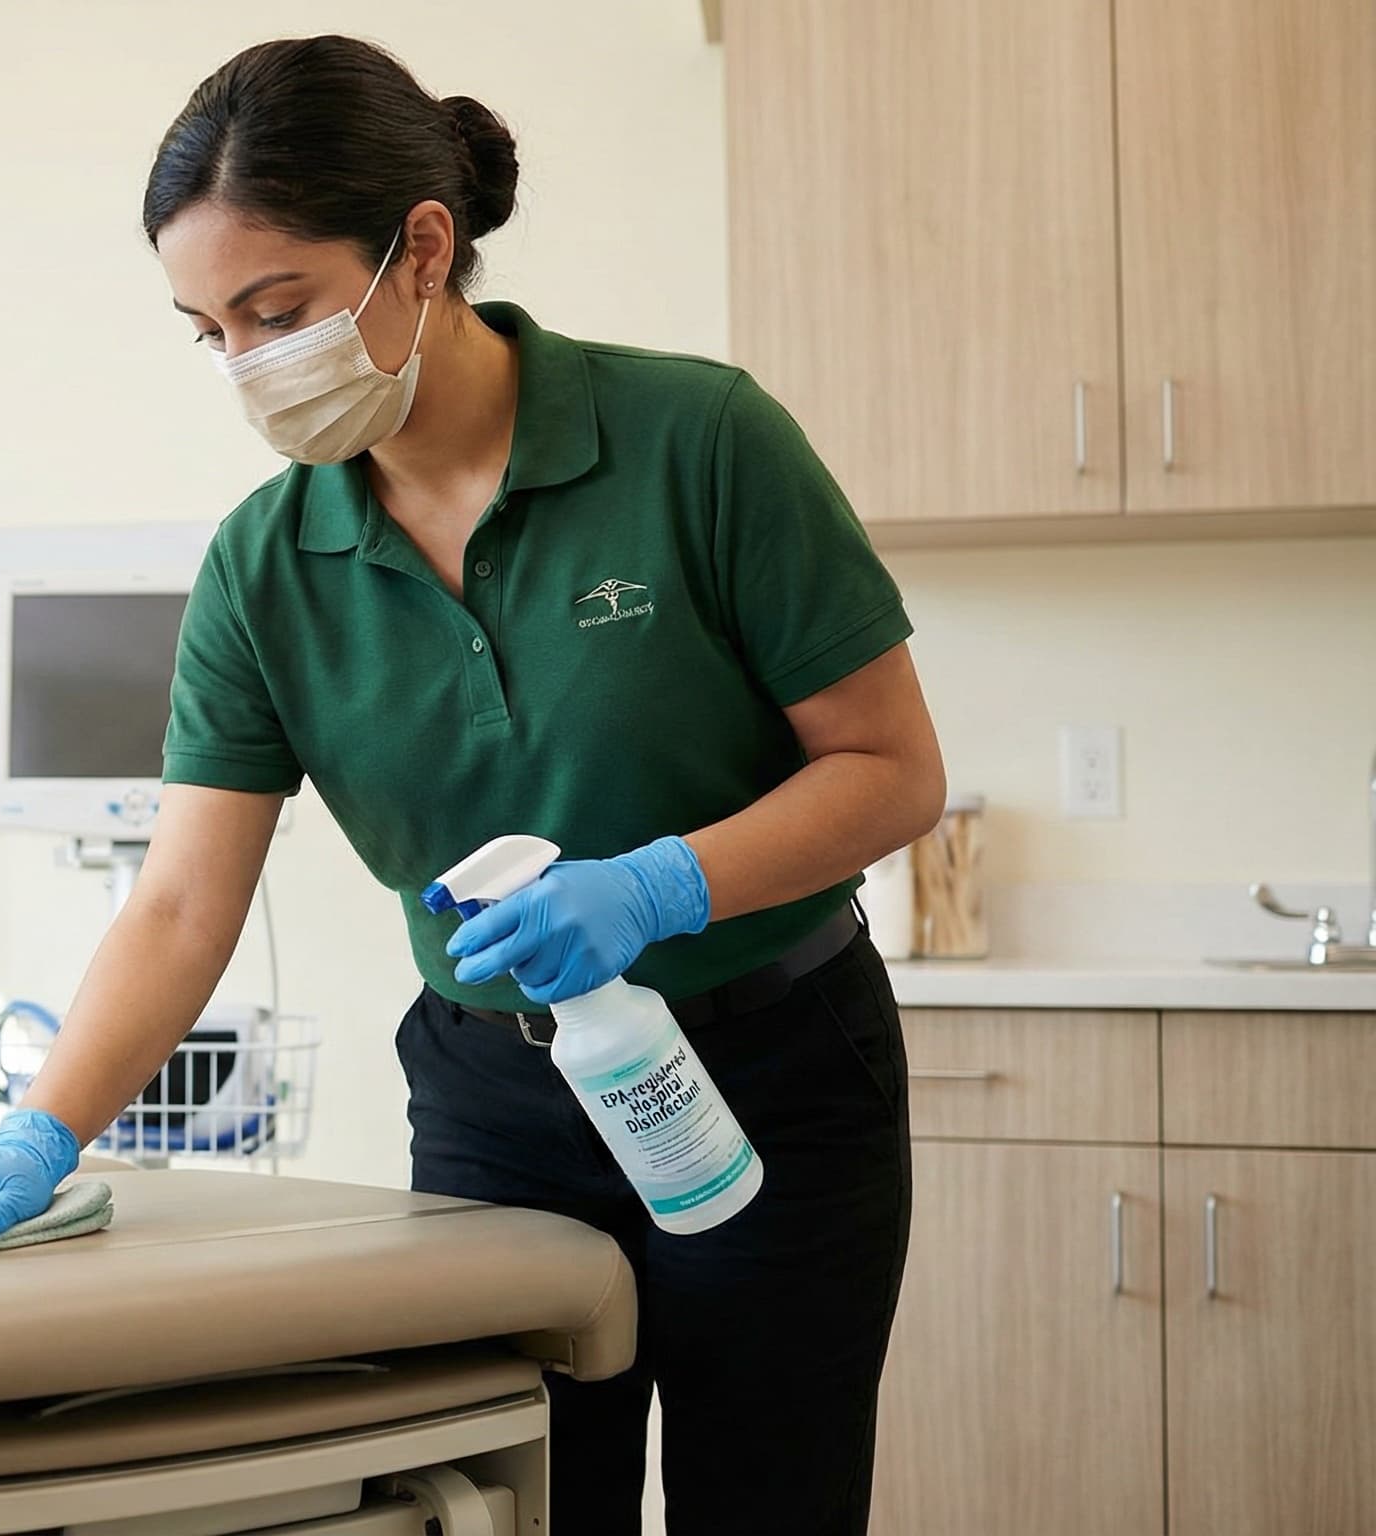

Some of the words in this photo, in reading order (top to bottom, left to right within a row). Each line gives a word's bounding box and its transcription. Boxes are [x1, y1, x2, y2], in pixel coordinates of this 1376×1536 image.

[600, 1046, 686, 1108] EPA-registered
[629, 1073, 684, 1115] Hospital
[625, 1079, 701, 1133] Disinfectant
